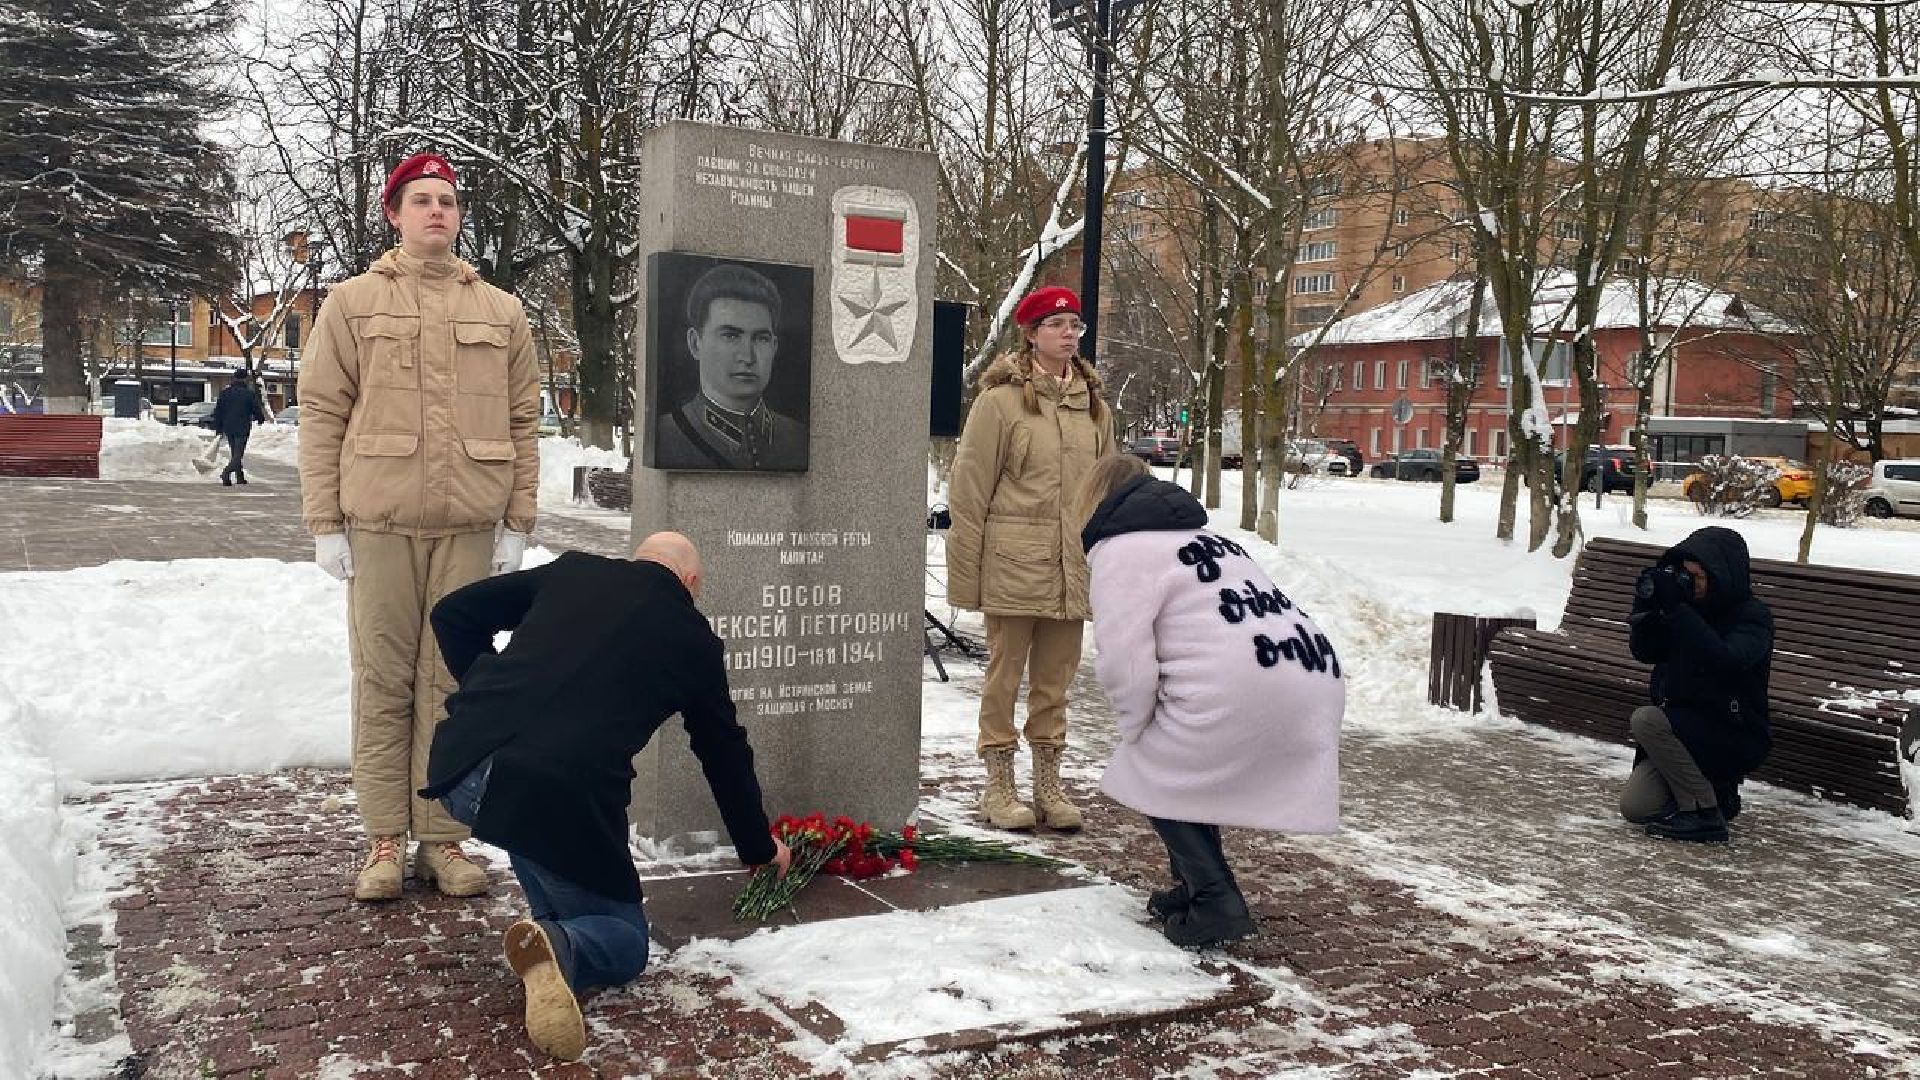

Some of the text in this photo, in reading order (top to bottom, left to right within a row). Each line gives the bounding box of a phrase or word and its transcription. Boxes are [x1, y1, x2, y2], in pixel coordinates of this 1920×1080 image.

[749, 143, 791, 161] ВЕЧНАЯ
[746, 161, 759, 175] ЗА
[731, 190, 773, 209] РОДИНЫ
[780, 550, 825, 565] КАПИТАН
[762, 585, 842, 608] БОСОВ
[706, 609, 909, 639] ЛЕКСЕЙ ПЕТРОВИЧ
[842, 641, 884, 664] 1941
[1253, 624, 1341, 678] only
[729, 686, 755, 701] ОГИБ
[759, 686, 773, 700] НА
[816, 697, 854, 712] МОСКВУ
